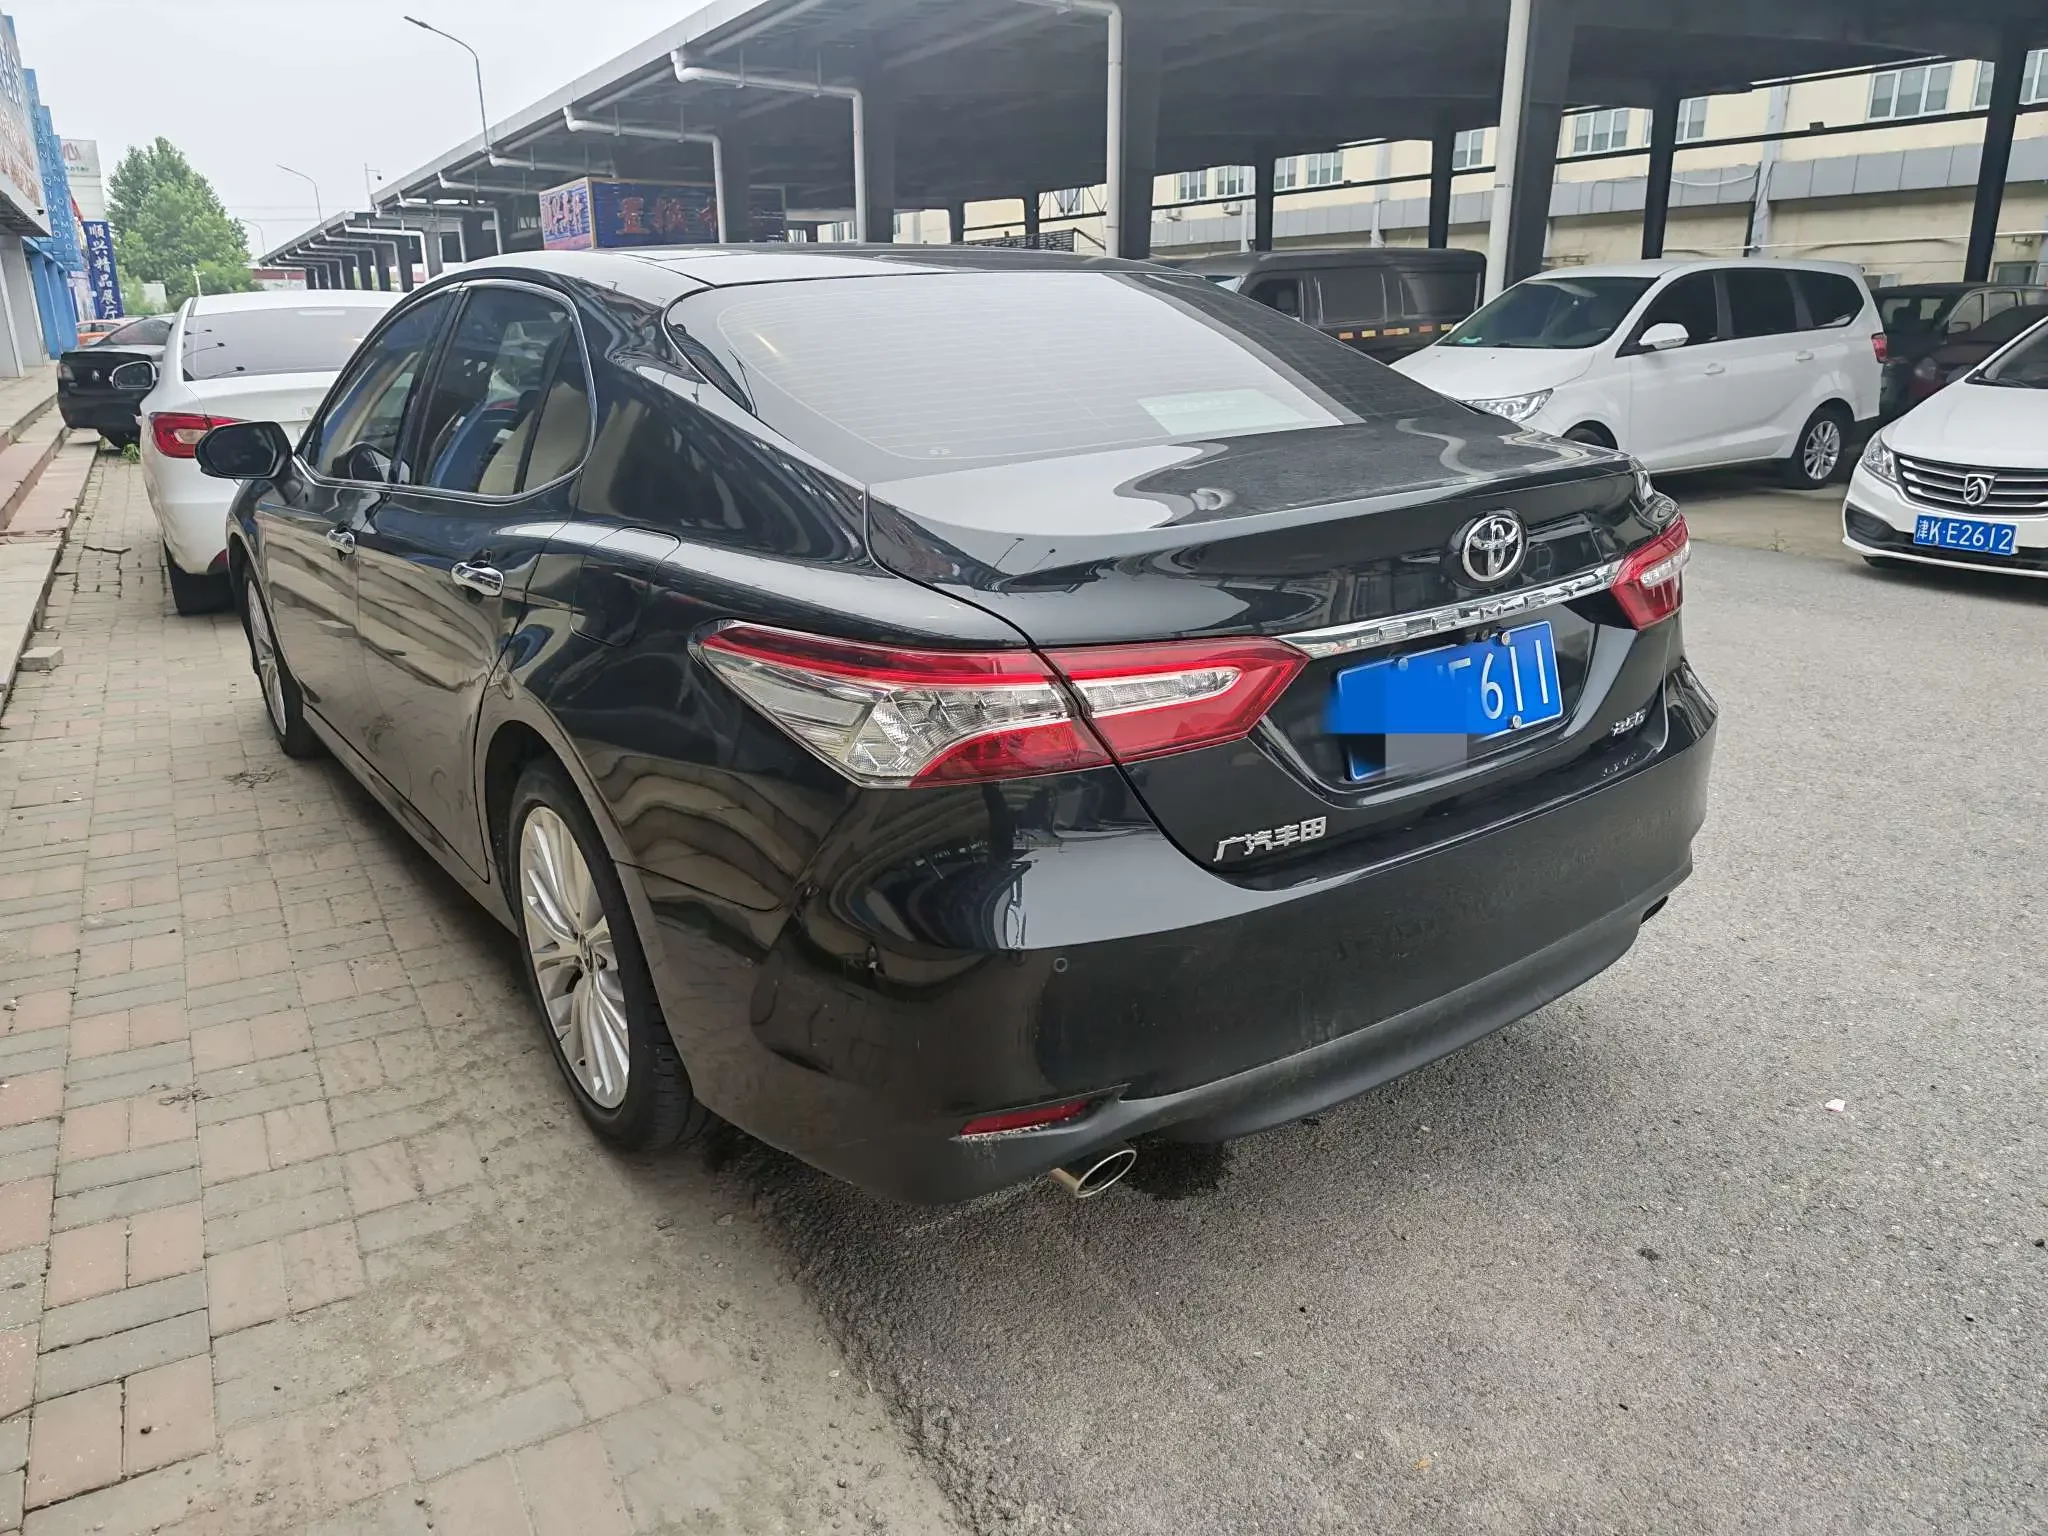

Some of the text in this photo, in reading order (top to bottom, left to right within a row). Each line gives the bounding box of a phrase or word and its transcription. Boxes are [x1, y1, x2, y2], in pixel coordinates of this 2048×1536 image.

[88, 223, 119, 320] 顺兴精品展厅
[1213, 816, 1327, 862] 广汽丰田
